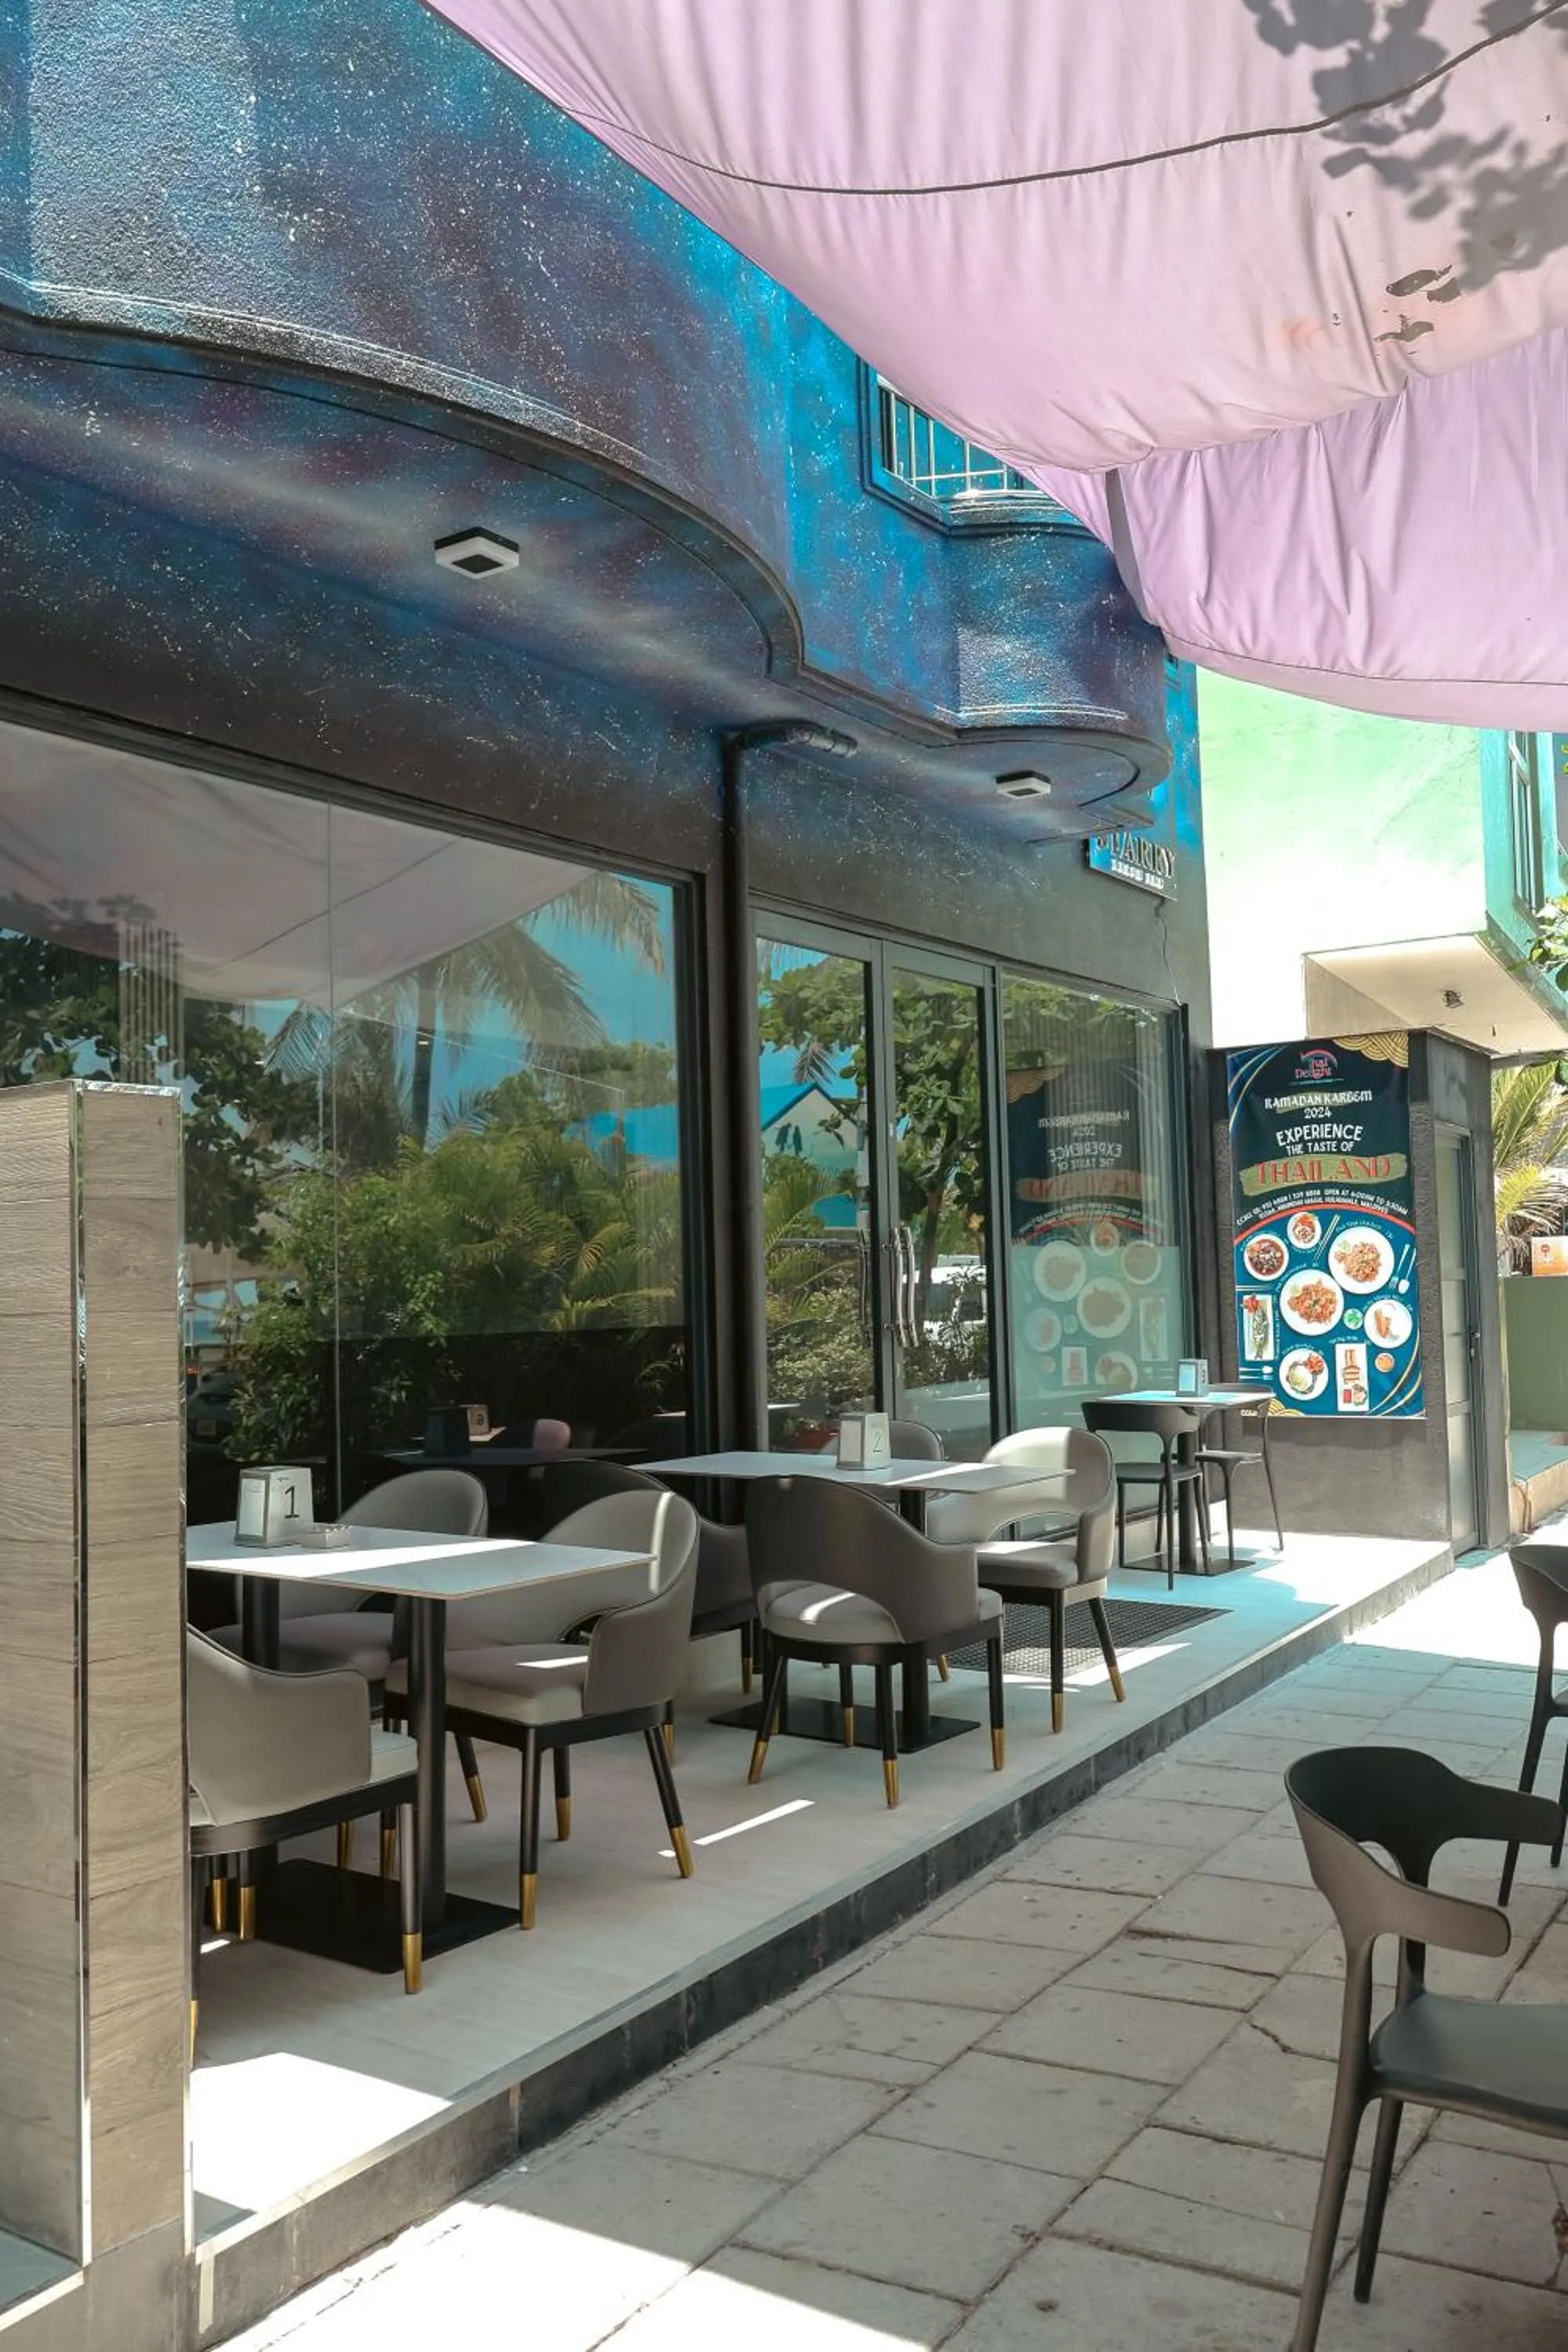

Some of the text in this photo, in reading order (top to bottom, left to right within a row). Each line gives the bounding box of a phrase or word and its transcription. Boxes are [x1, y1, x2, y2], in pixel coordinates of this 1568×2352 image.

[1304, 1106, 1332, 1119] 2024
[1276, 1123, 1363, 1146] EXPERIENCE
[1286, 1141, 1355, 1156] THE TASTE OF
[873, 1430, 882, 1452] 2
[285, 1486, 299, 1519] 1
